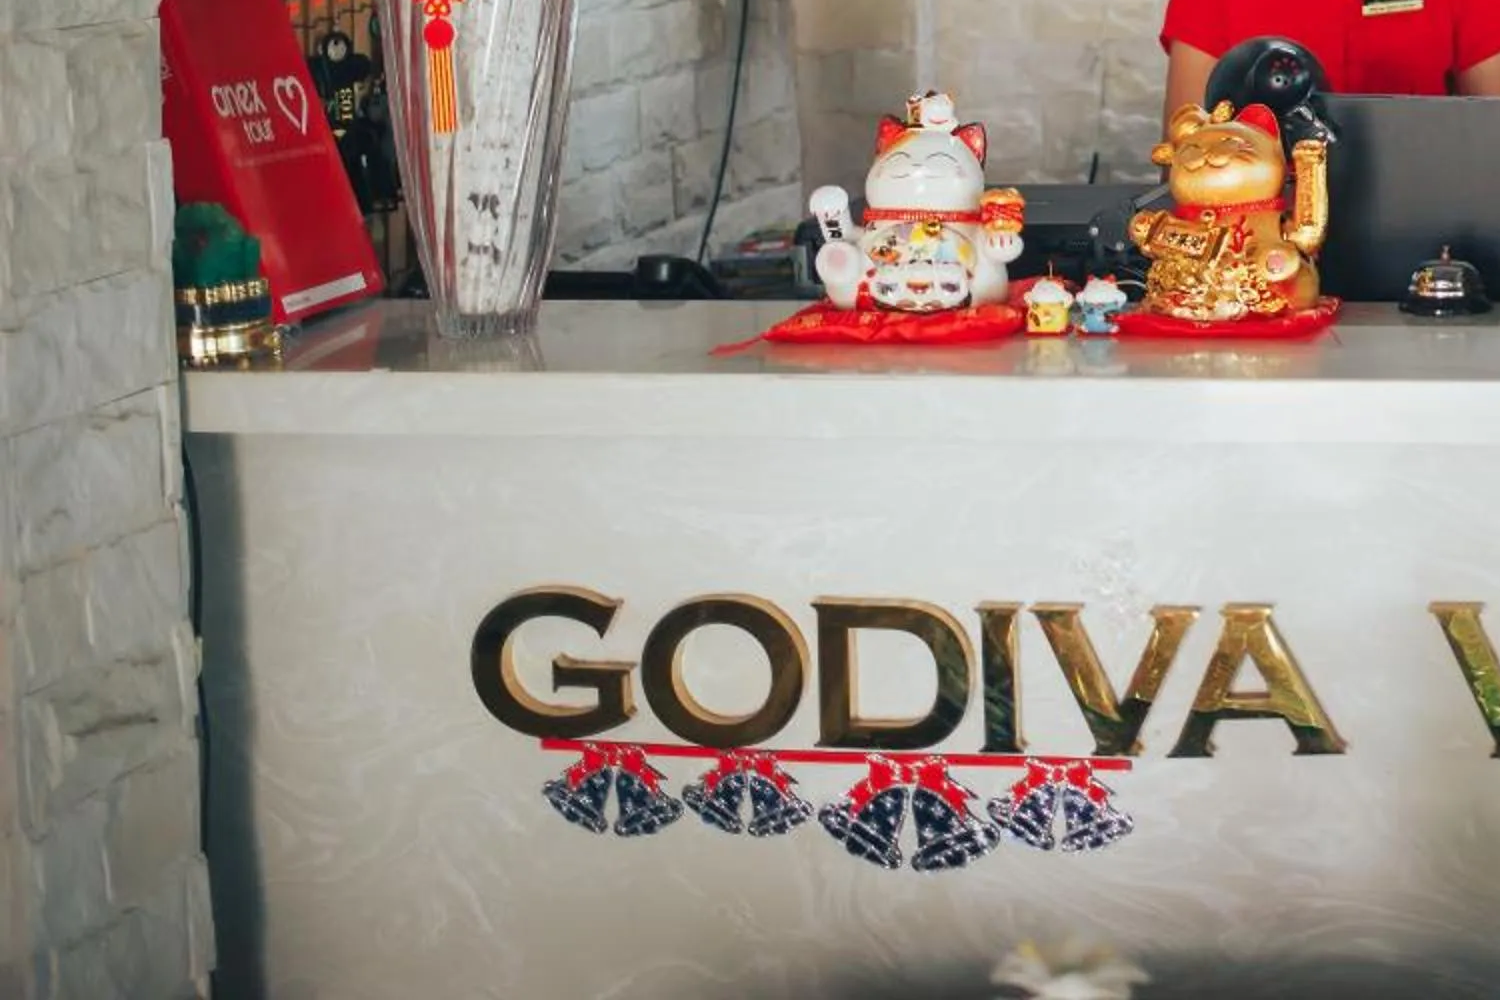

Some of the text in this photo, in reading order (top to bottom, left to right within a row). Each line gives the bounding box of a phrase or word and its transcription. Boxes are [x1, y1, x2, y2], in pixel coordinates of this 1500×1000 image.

[211, 79, 267, 118] anex
[243, 117, 276, 144] tour
[470, 585, 1349, 758] GODIVA
